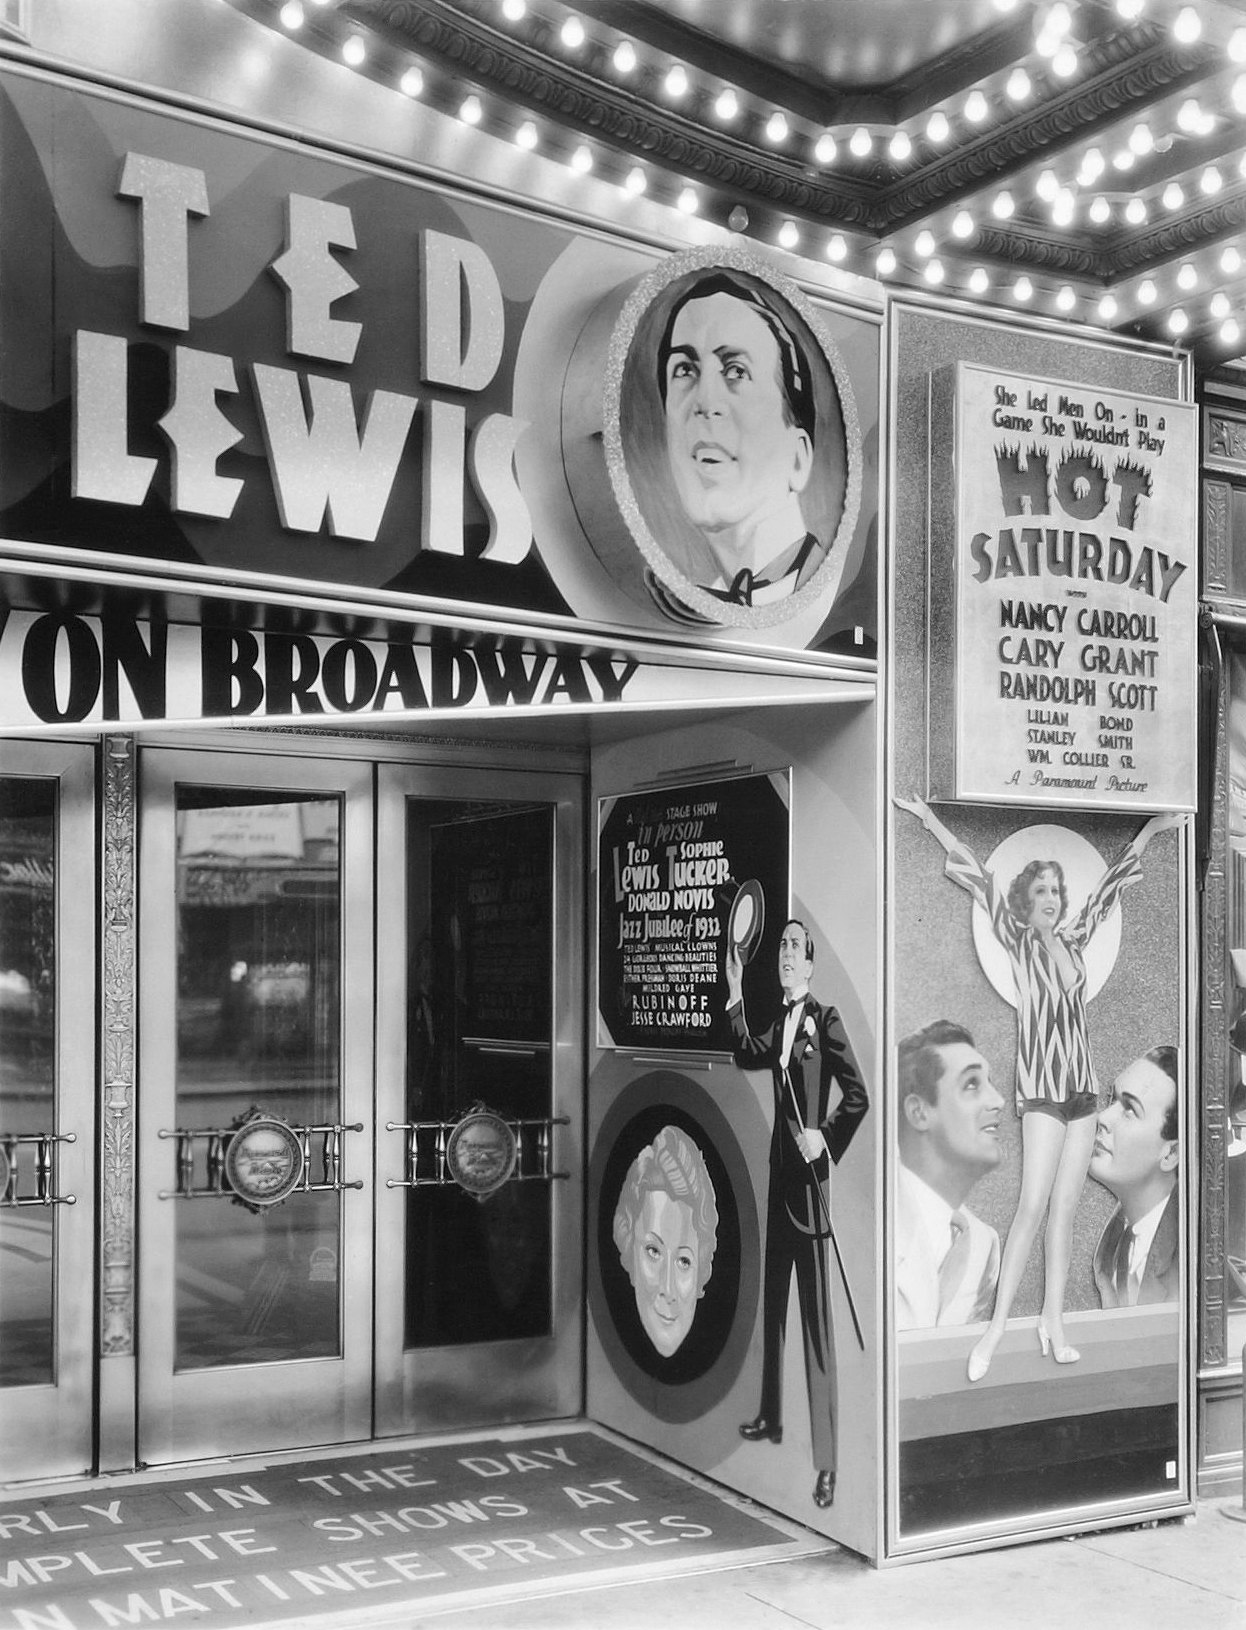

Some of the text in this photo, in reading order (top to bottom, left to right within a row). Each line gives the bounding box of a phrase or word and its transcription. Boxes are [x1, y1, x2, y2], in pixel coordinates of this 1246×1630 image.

[117, 151, 505, 392] TED
[994, 385, 1018, 408] She
[1027, 390, 1048, 412] Led
[1058, 394, 1084, 418] Men
[1095, 401, 1113, 422] On
[1158, 417, 1166, 431] a
[71, 329, 532, 565] LEWIS
[993, 408, 1033, 432] Game
[1042, 415, 1066, 437] She
[1138, 431, 1165, 457] Play
[994, 438, 1153, 531] HOT
[971, 528, 1187, 602] SATURDAY
[1000, 599, 1159, 643] NANCY CARROLL
[22, 612, 640, 723] ON BROADWAY
[999, 636, 1159, 678] CARY GRANT
[1000, 671, 1158, 711] RANDOLPH SCOTT
[1027, 709, 1133, 731] LILIAN BOND
[1027, 729, 1133, 750] STANLEY SMITH
[1063, 752, 1109, 767] COLLIER
[1005, 770, 1148, 792] A Paramount Picture
[666, 805, 690, 820] STAGE
[693, 802, 718, 818] SHOW
[638, 820, 704, 848] in person
[674, 888, 715, 912] NOVIS
[618, 912, 642, 949] Jazz
[683, 911, 697, 943] of
[695, 917, 721, 940] 1932
[655, 942, 685, 953] MUSICAL
[687, 941, 717, 952] CLOWNS
[659, 953, 684, 962] DANCING
[685, 951, 717, 962] BEAUTIES
[643, 984, 671, 993] MILDRED
[668, 973, 687, 982] DORIS
[690, 973, 717, 983] DEANE
[631, 1011, 712, 1028] JESSE CRAWFORD
[632, 995, 709, 1011] RUBINOFF
[184, 1485, 271, 1512] IN
[298, 1464, 437, 1496] THE
[458, 1448, 578, 1477] DAY
[313, 1496, 529, 1541] SHOWS
[562, 1480, 640, 1508] AT
[88, 1552, 447, 1627] MATINEE
[449, 1516, 713, 1571] PRICES
